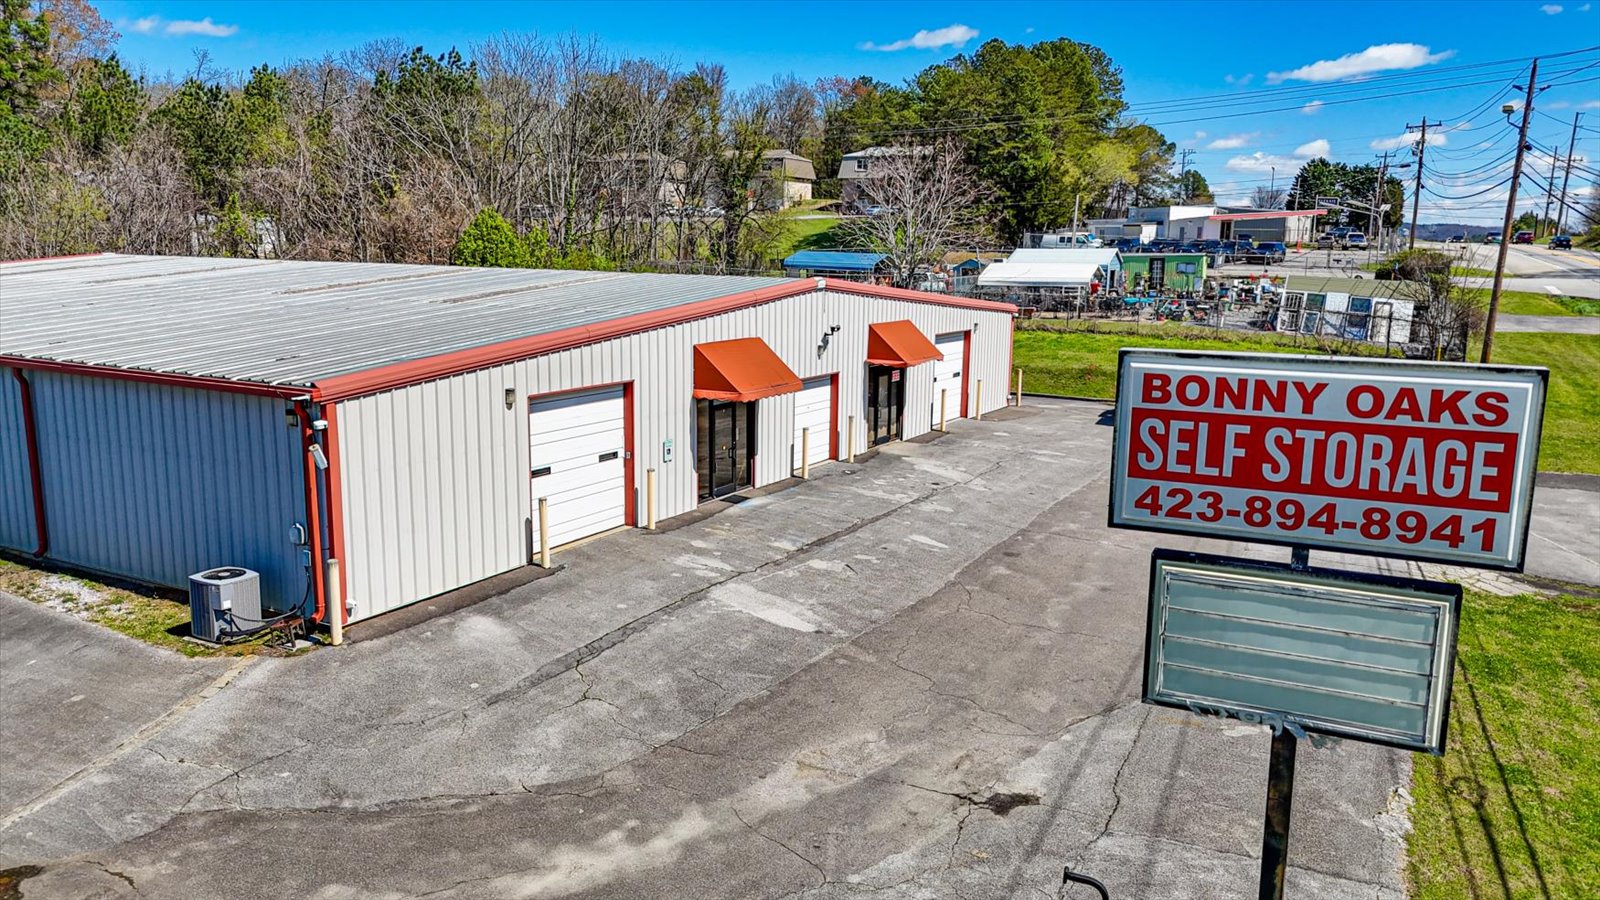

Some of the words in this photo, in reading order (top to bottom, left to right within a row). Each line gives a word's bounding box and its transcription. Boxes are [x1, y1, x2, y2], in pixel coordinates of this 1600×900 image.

[1142, 373, 1328, 414] BONNY
[1346, 384, 1508, 427] OAKS
[1136, 417, 1251, 478] SELF
[1261, 426, 1505, 502] STORAGE
[1134, 485, 1497, 552] 423-894-8941
